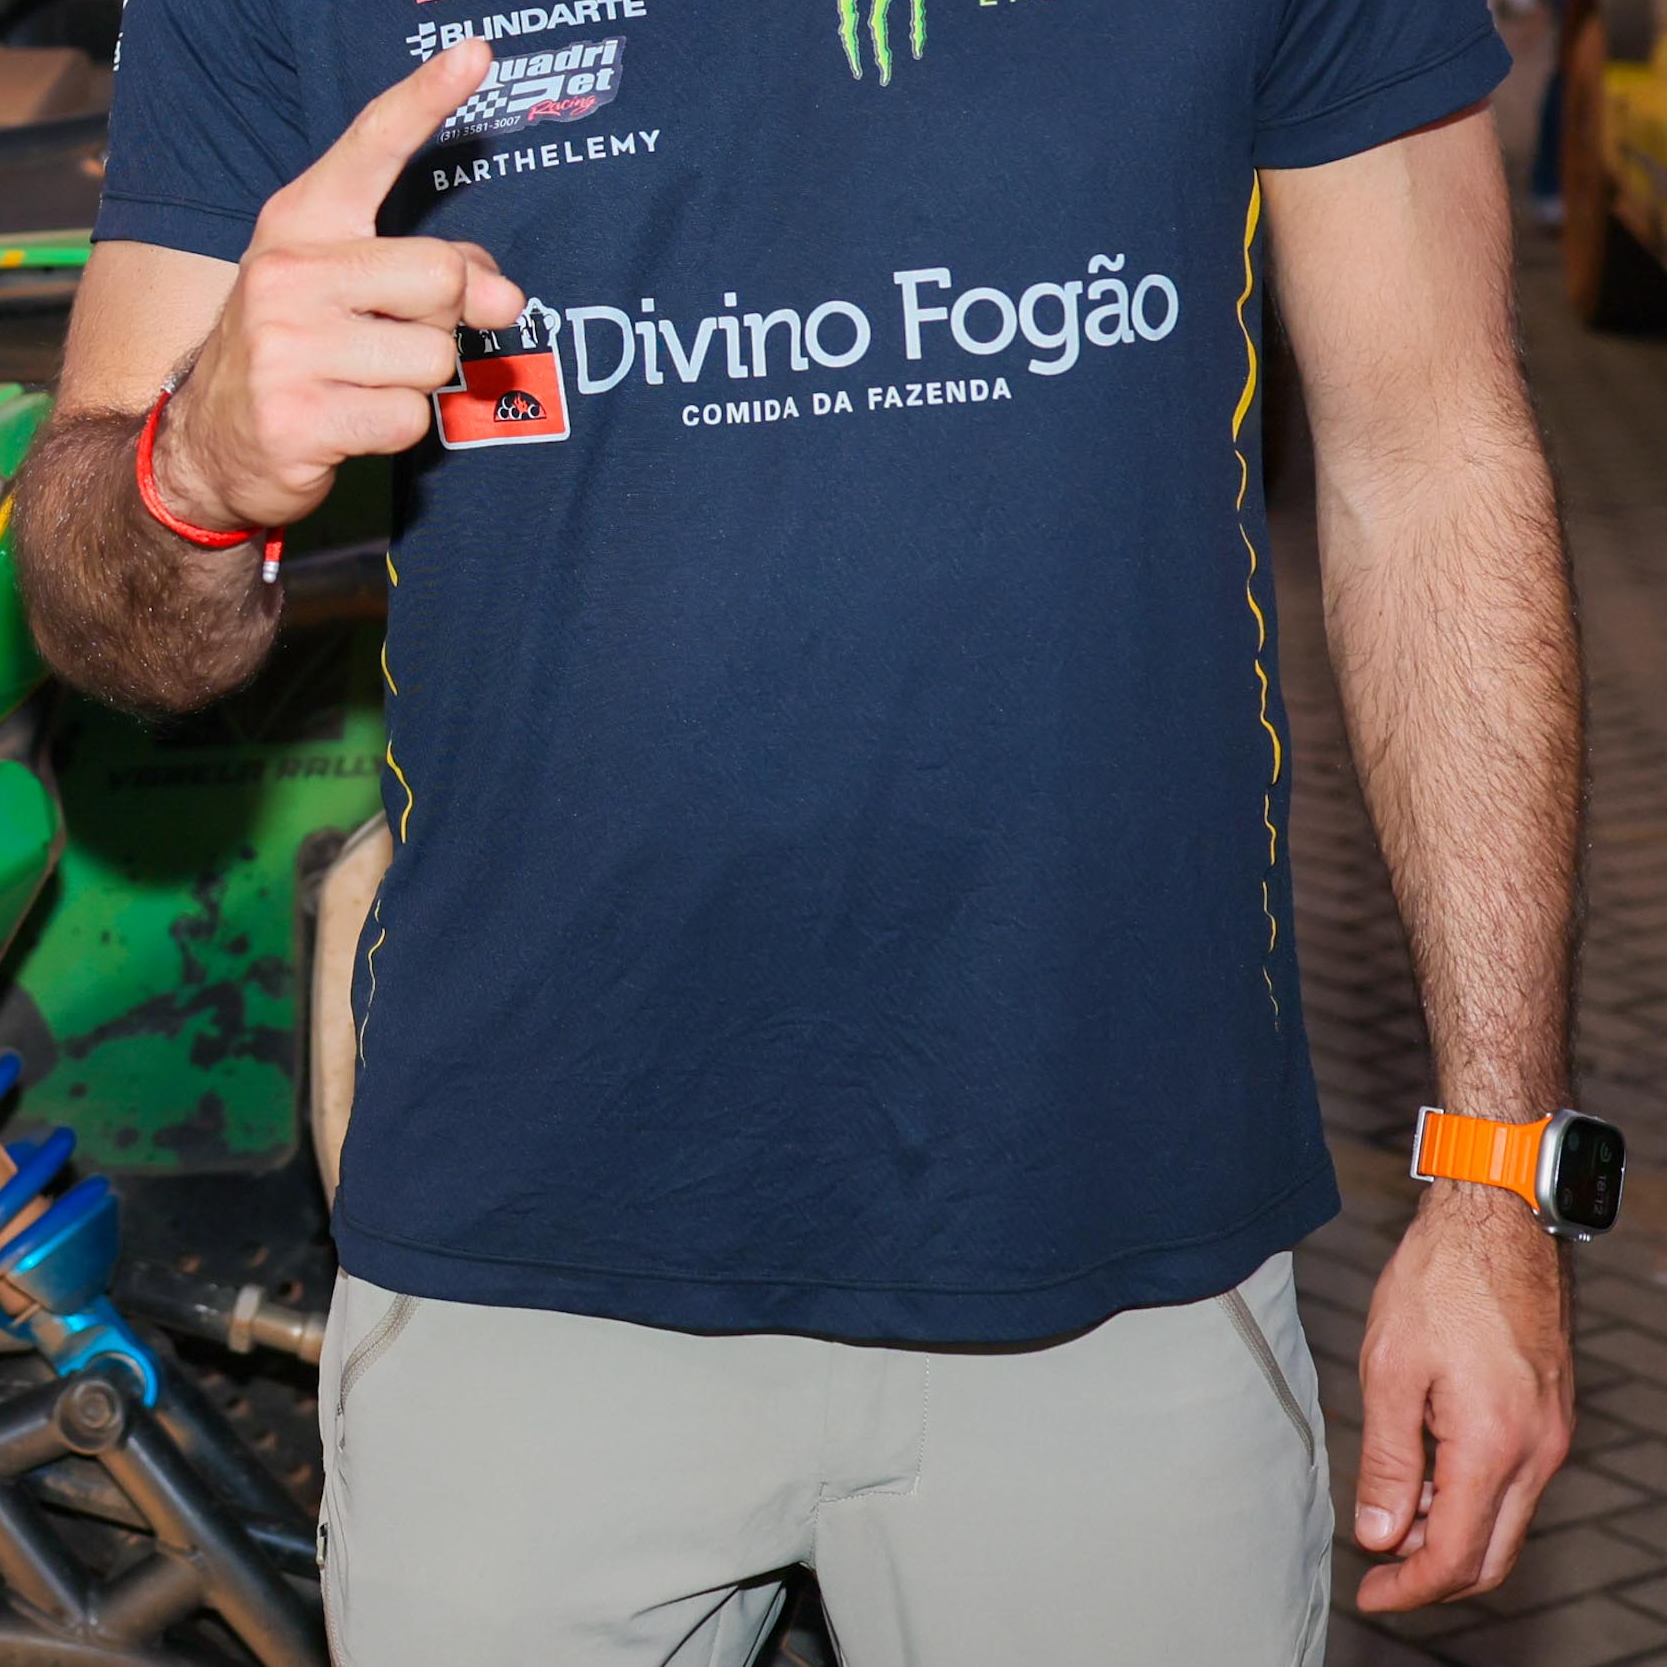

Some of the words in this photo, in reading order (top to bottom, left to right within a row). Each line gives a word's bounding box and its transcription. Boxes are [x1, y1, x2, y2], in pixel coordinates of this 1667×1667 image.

[439, 127, 460, 144] (31)
[463, 115, 521, 136] 3581-3007
[527, 95, 596, 122] Racing
[433, 129, 661, 192] BARTHELEMY
[566, 291, 870, 396] Divino
[893, 253, 1180, 377] Fogão
[682, 396, 800, 427] COMIDA
[812, 390, 854, 416] DA
[868, 376, 1012, 412] FAZENDA
